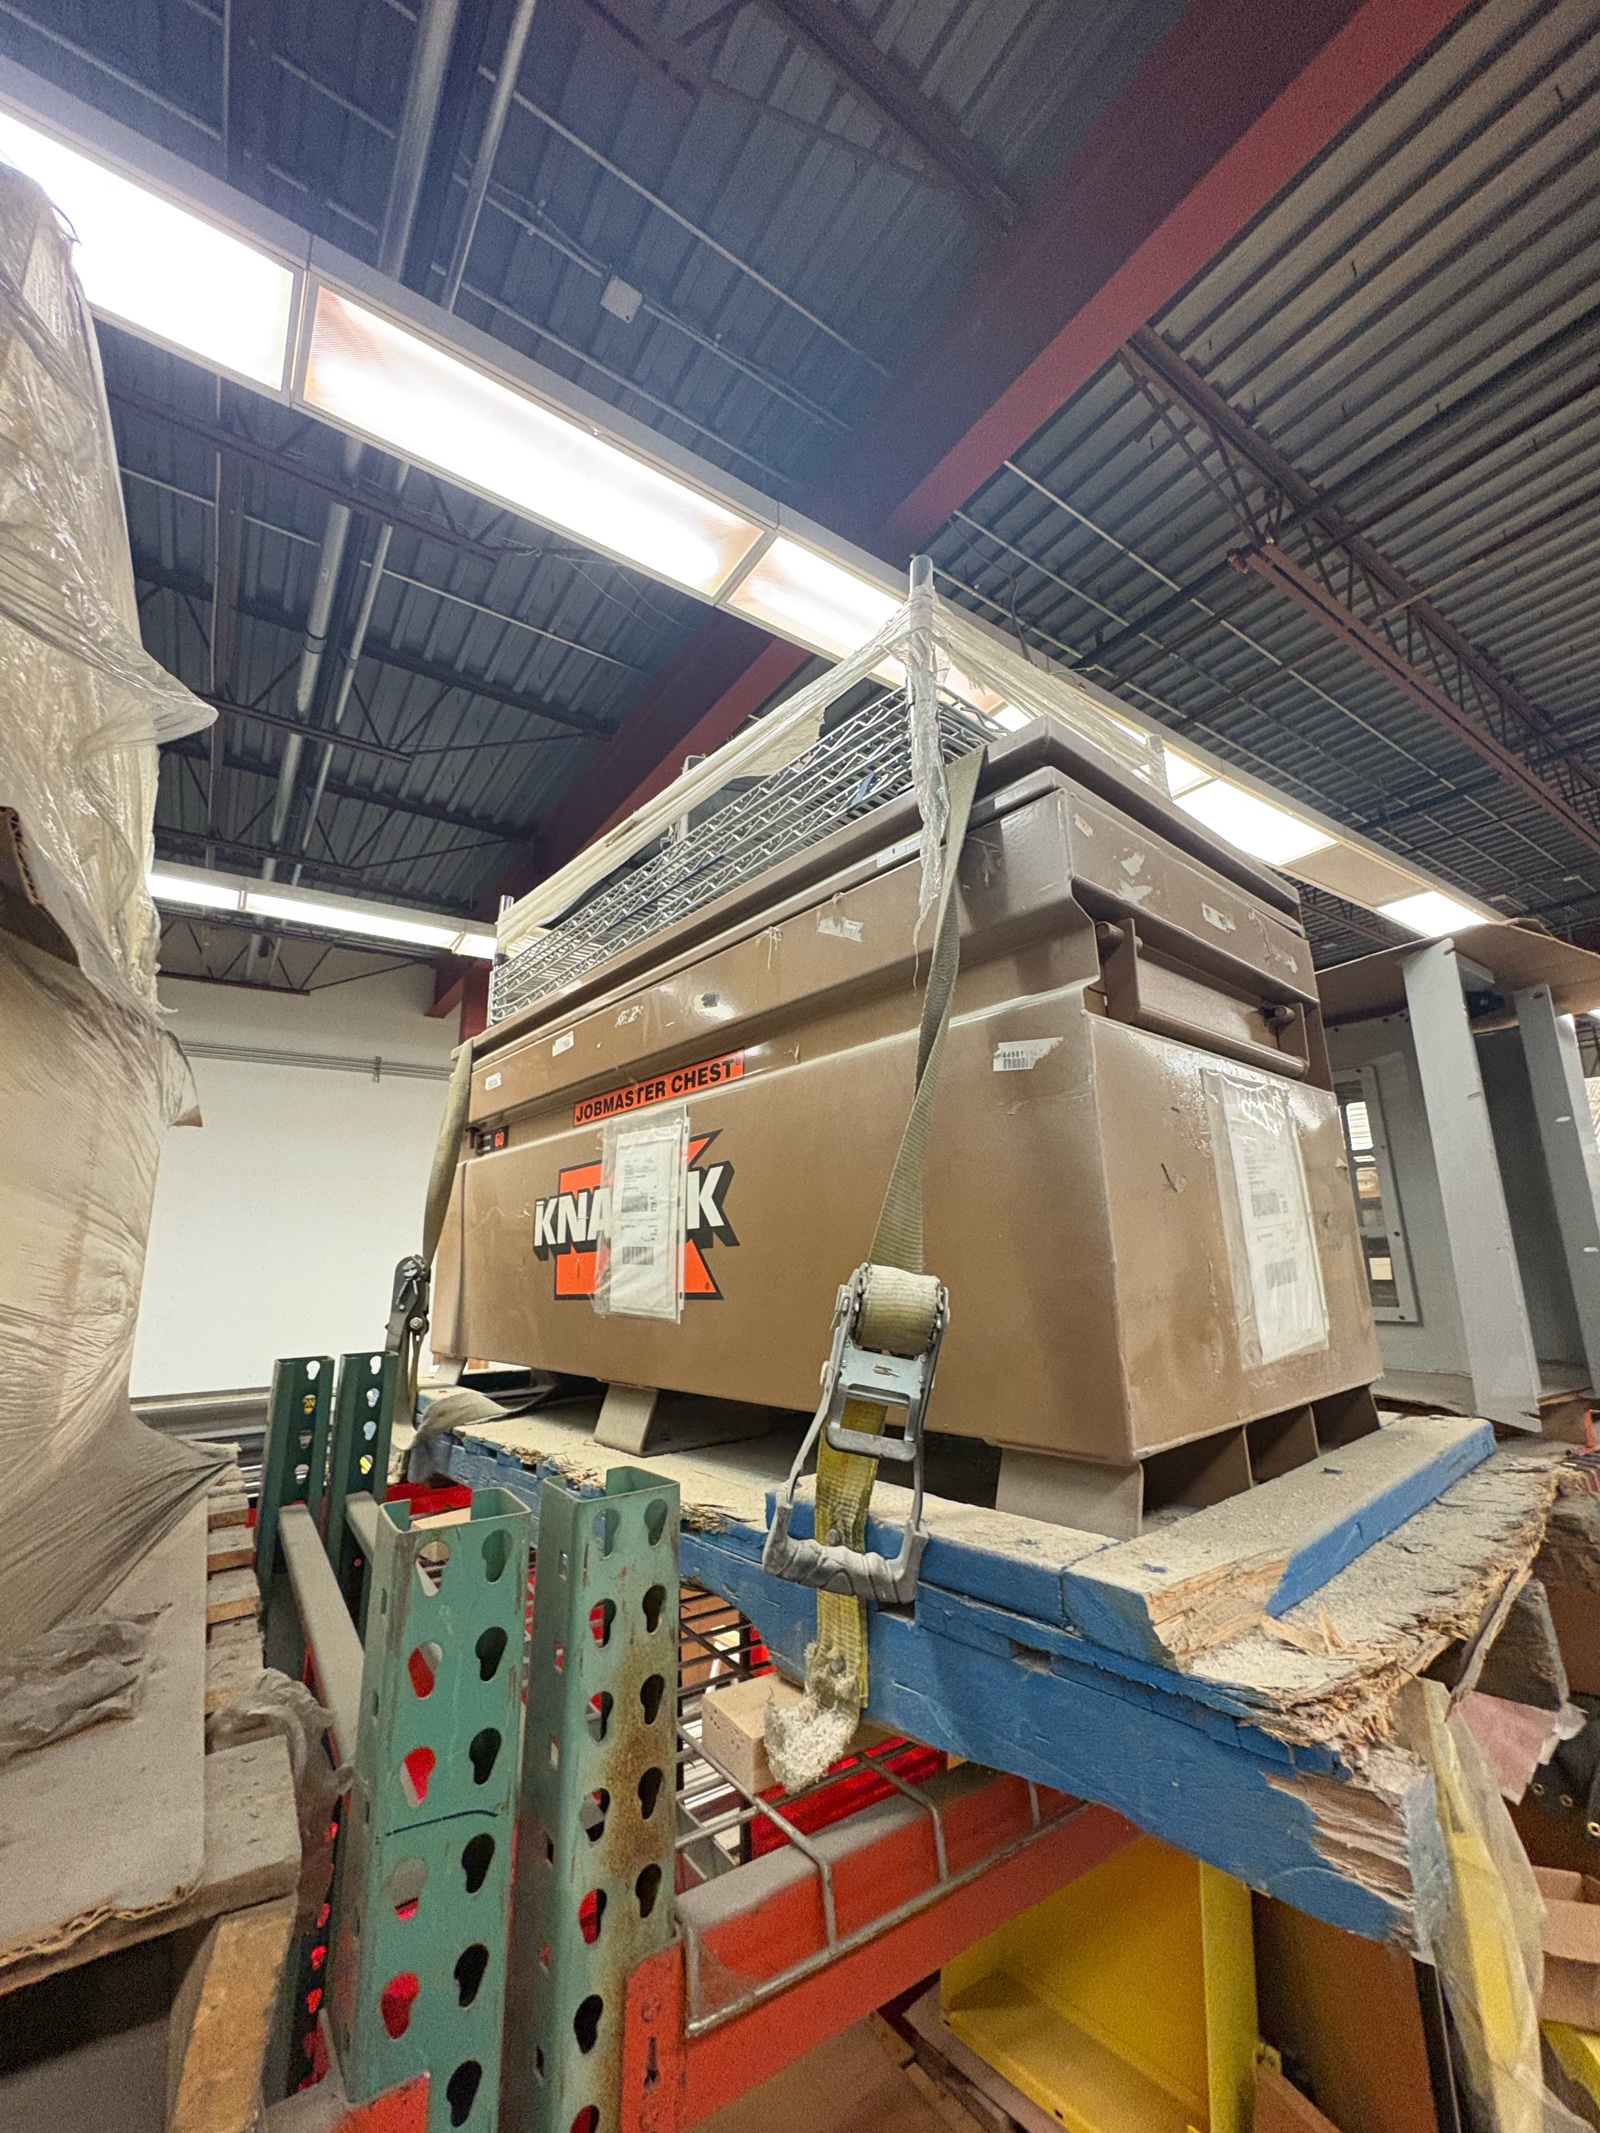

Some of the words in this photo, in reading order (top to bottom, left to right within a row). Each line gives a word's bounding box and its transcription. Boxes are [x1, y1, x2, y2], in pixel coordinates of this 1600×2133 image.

[576, 1080, 666, 1122] JOBMASTER
[671, 1059, 734, 1093] CHEST
[494, 1131, 505, 1147] 60
[534, 1165, 725, 1246] KNAK
